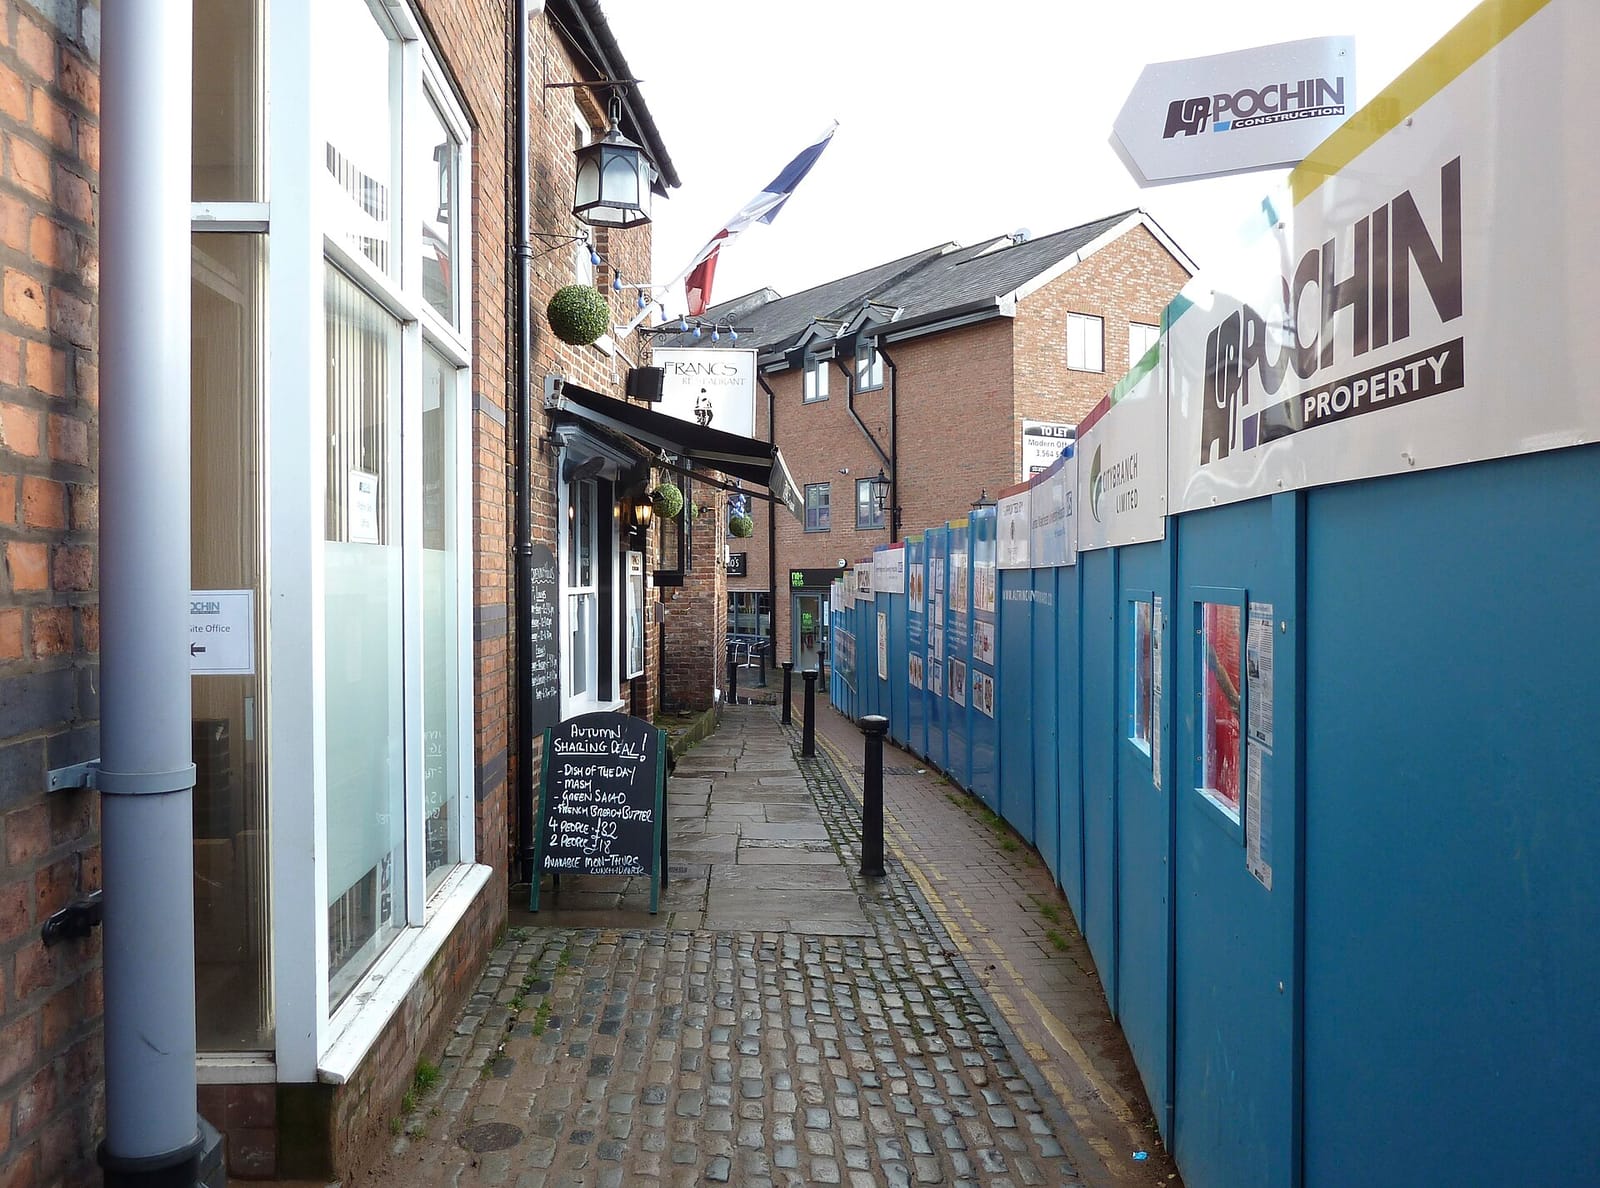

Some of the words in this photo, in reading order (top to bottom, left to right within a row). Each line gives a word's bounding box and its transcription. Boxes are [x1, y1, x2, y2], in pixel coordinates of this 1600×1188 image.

[1213, 77, 1344, 122] POCHIN
[1235, 108, 1344, 128] CONSTRUCTION
[1241, 155, 1463, 407] POCHIN
[664, 361, 738, 376] FRANCS
[1303, 350, 1450, 423] PROPERTY
[1040, 426, 1052, 436] TO
[1053, 427, 1068, 438] LET
[1028, 439, 1055, 447] Modern
[1103, 452, 1138, 493] CITYBRANCH
[1116, 488, 1139, 513] LIMITED
[205, 624, 231, 633] Office
[571, 723, 621, 739] AUTUMN
[548, 816, 558, 832] 4
[549, 834, 558, 847] 2
